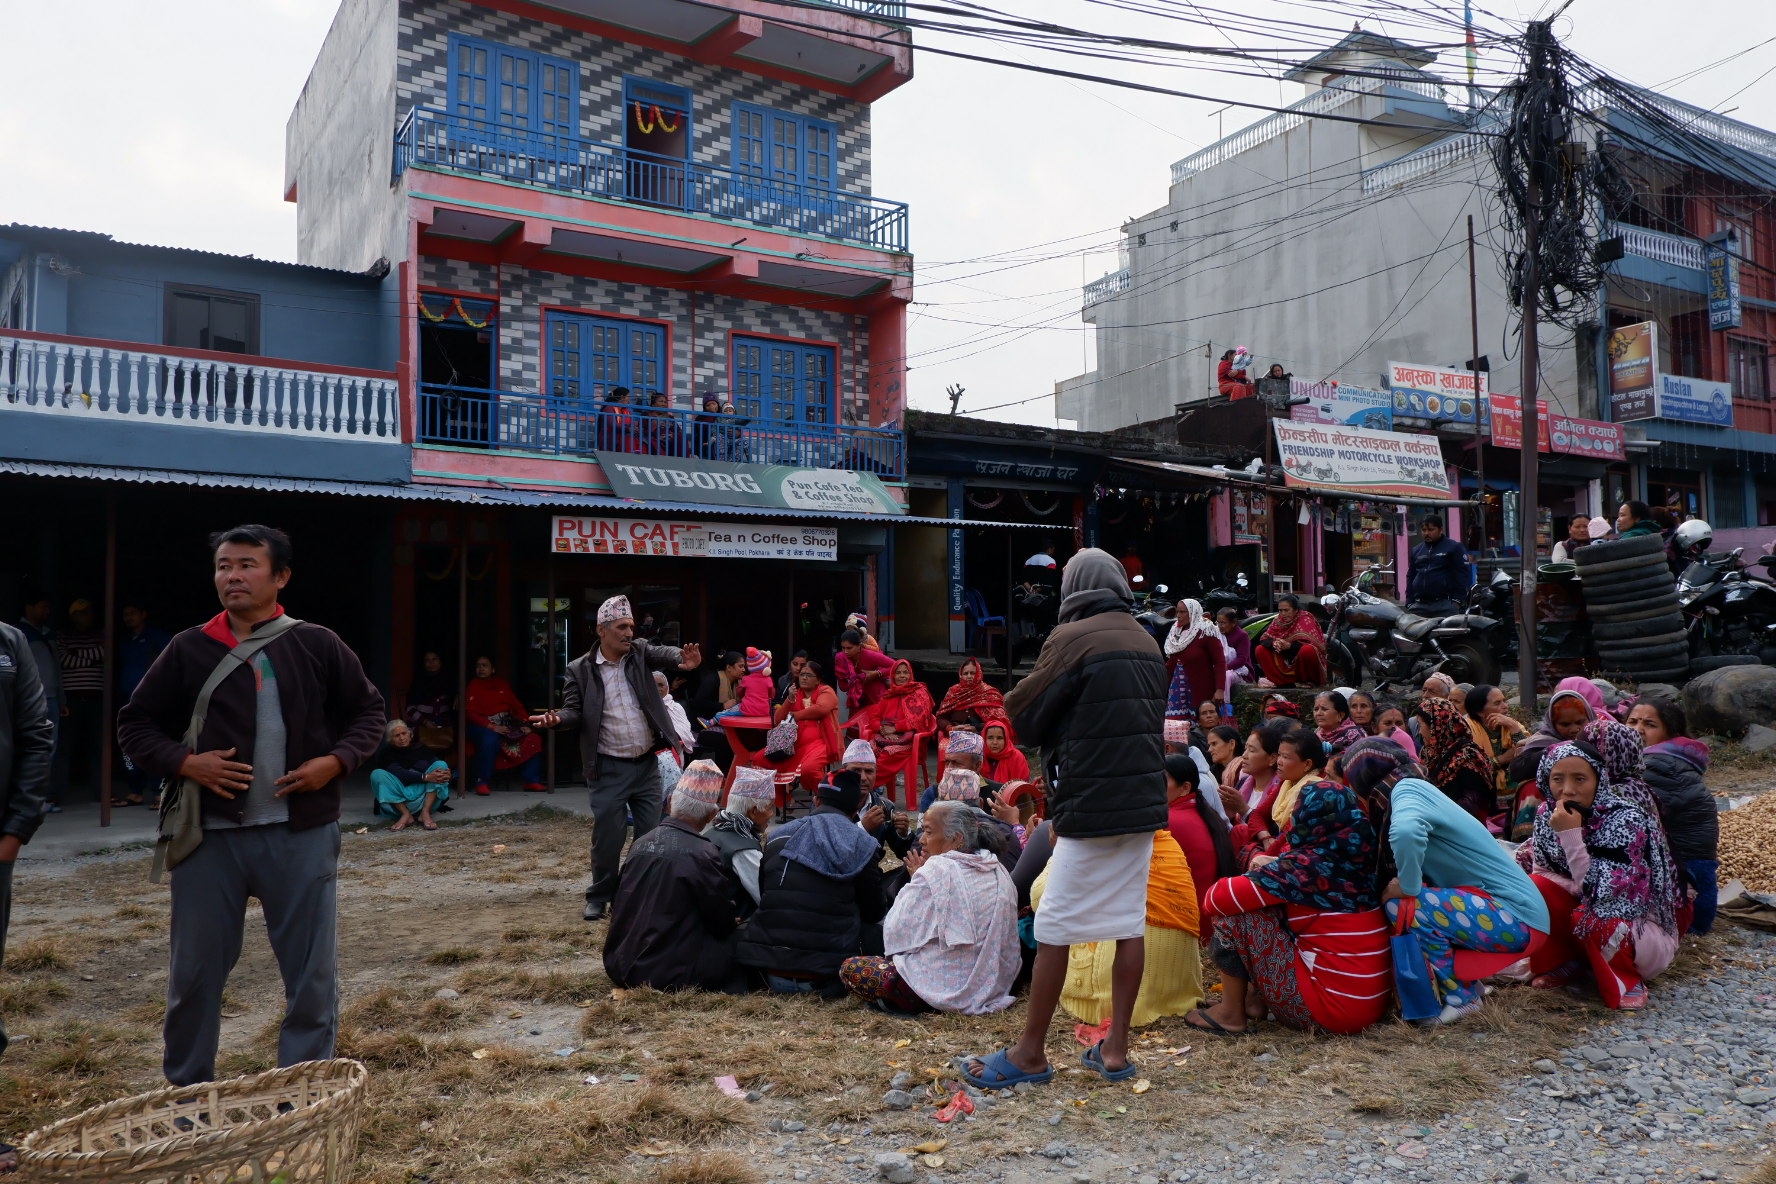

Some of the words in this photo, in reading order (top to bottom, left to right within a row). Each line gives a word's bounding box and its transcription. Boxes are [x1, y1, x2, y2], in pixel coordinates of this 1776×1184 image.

[1291, 379, 1337, 400] UNIQUE
[1338, 387, 1391, 400] COMMUNICATION
[1664, 376, 1692, 397] Ruslan
[1352, 396, 1370, 405] PHOTO
[1371, 398, 1391, 408] STUDIO
[1282, 444, 1335, 459] FRIENDSHIP
[1338, 449, 1393, 465] MOTORCYCLE
[1394, 455, 1441, 470] WORKSHOP
[614, 463, 763, 494] TUBORG
[1016, 463, 1055, 478] खाजा
[1056, 466, 1079, 481] घर
[787, 480, 812, 490] Pun
[814, 482, 841, 492] Cafe
[841, 483, 864, 494] Tea
[792, 491, 803, 500] &
[805, 491, 843, 503] Coffee
[844, 494, 875, 506] Shop
[558, 519, 619, 540] PUN
[629, 522, 702, 541] CAF
[952, 508, 961, 538] Paion
[708, 531, 732, 543] Tea
[737, 534, 746, 543] n
[751, 532, 798, 546] Coffee
[802, 535, 837, 549] Shop
[717, 548, 734, 557] Singh
[748, 549, 770, 557] Pokhara
[952, 540, 961, 580] Endurance
[953, 583, 964, 611] Quality
